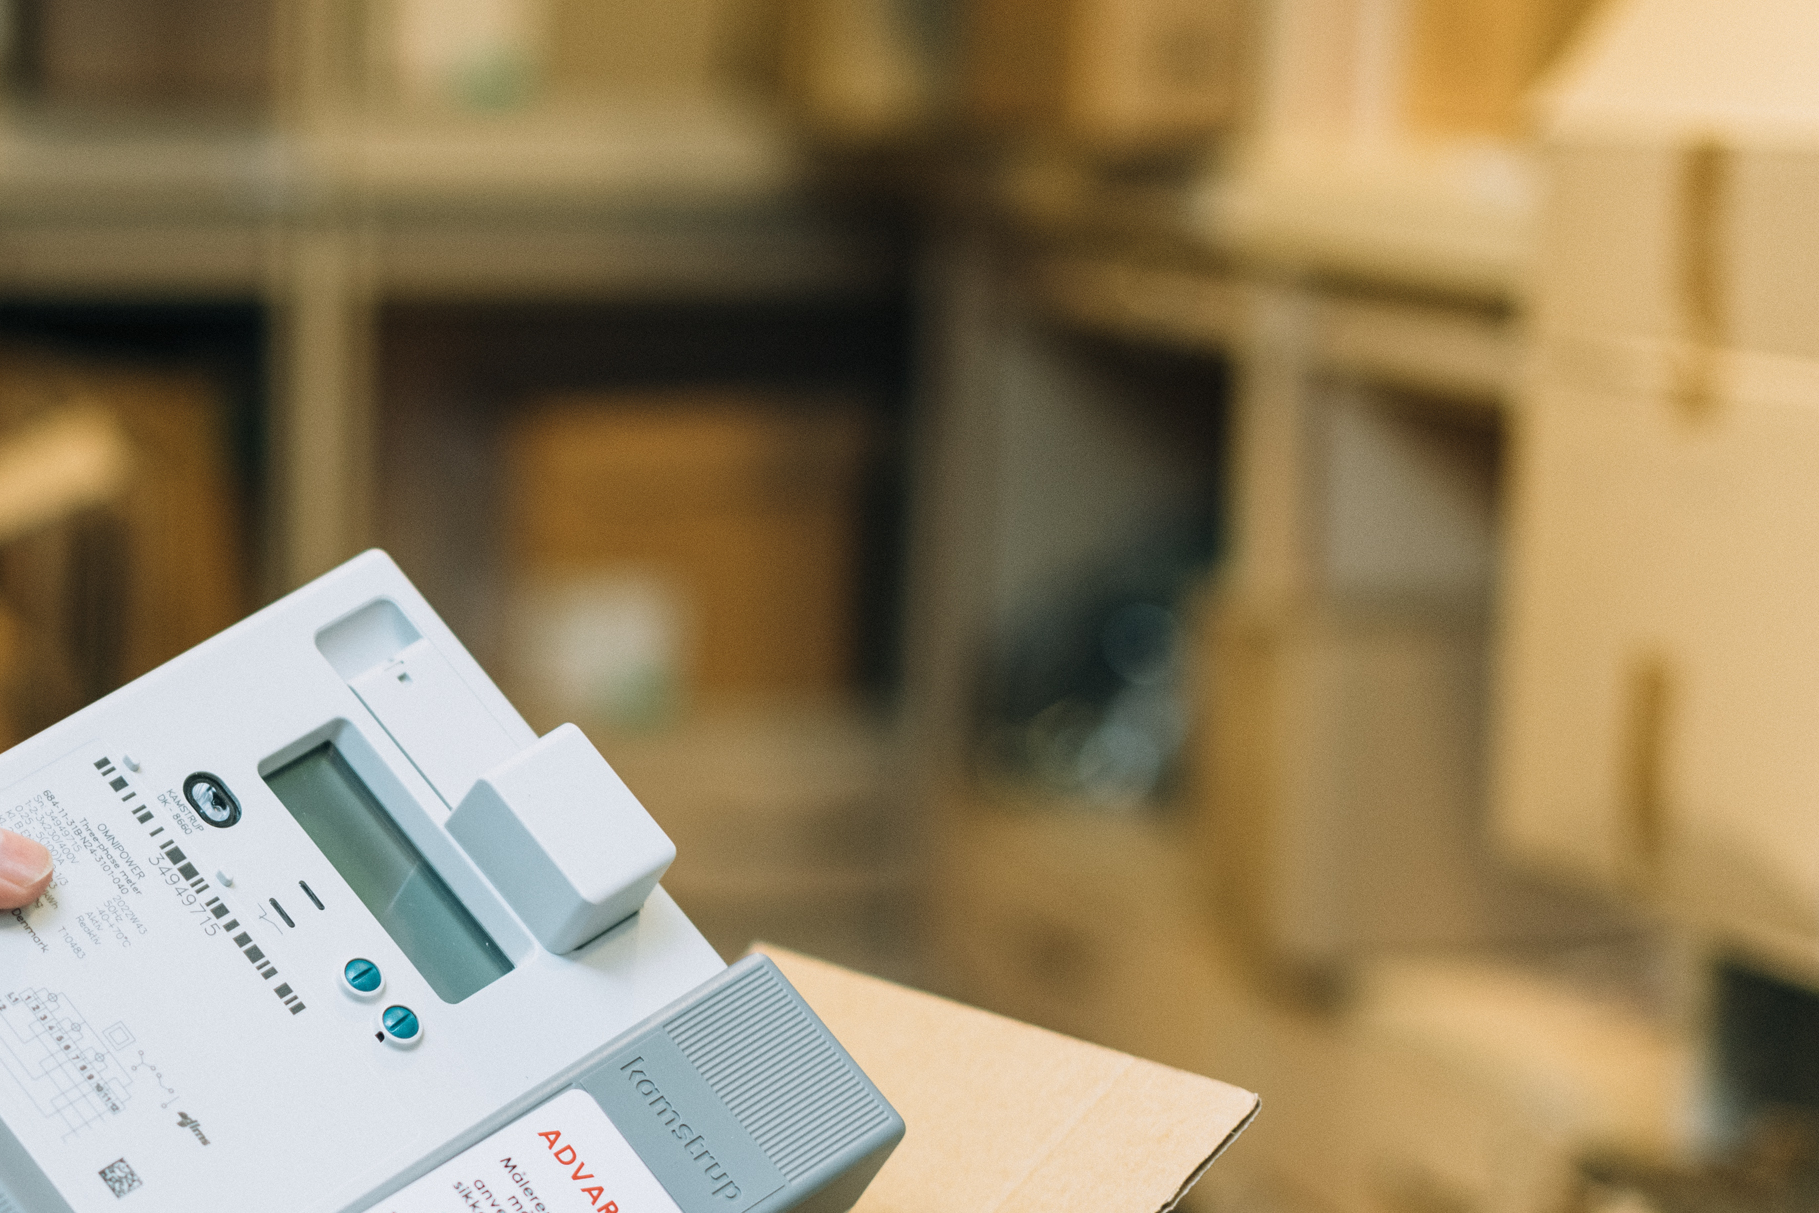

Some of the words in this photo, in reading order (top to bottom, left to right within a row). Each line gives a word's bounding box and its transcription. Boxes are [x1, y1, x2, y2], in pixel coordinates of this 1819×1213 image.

[14, 805, 33, 824] 0.25
[157, 794, 169, 806] DK
[172, 813, 192, 834] 8660
[167, 789, 204, 831] KAMSTRUP
[44, 809, 82, 852] 34949715
[79, 817, 121, 868] Three-phase
[120, 870, 142, 894] meter
[97, 823, 145, 879] OMNIPOWER
[103, 900, 123, 922] 50Hz
[148, 852, 221, 936] 34949715
[9, 907, 52, 953] Denmark
[75, 915, 101, 945] Reaktiv
[85, 911, 103, 931] Aktiv
[112, 895, 147, 934] 2022W43
[57, 926, 86, 959] T10483
[7, 992, 19, 1002] L1
[615, 1055, 747, 1207] kamstrup
